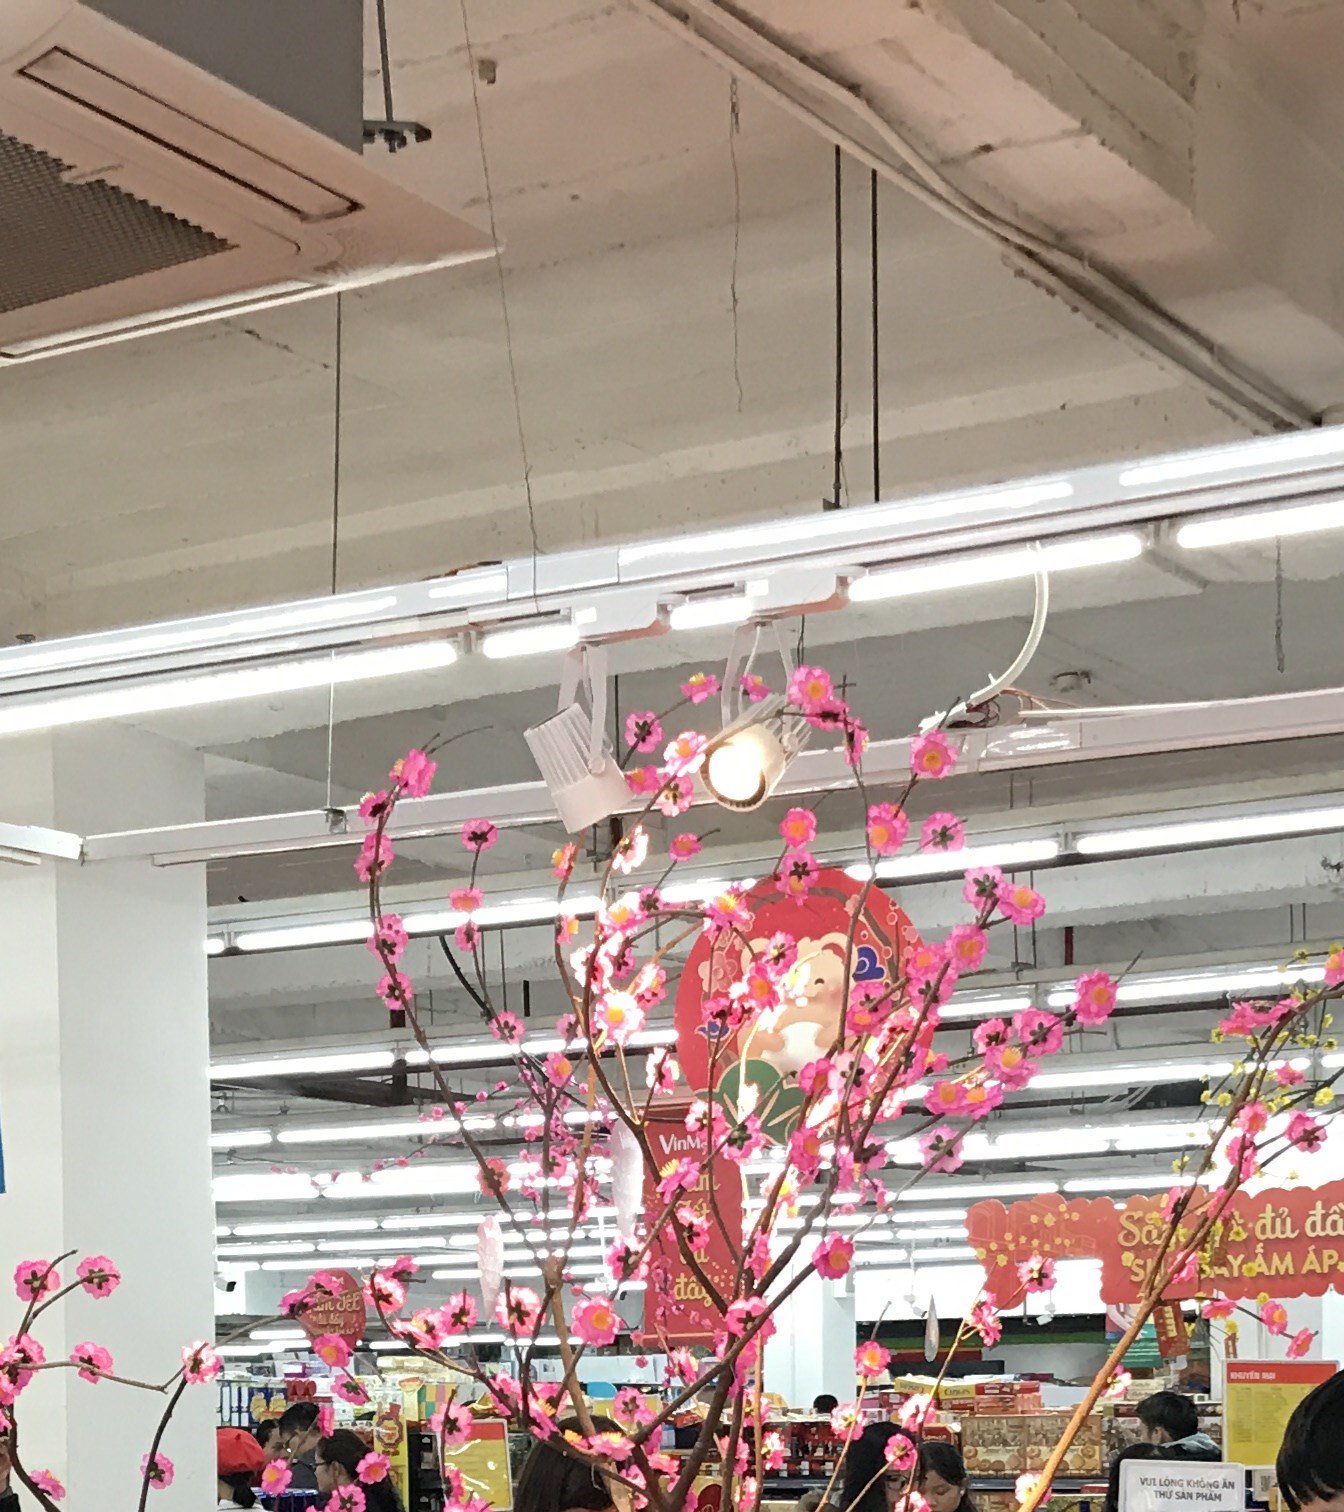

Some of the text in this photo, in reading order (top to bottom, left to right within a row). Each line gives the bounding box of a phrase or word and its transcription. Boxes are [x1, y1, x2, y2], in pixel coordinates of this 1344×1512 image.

[1256, 1203, 1299, 1240] đủ
[1301, 1244, 1339, 1274] ÁP
[1140, 1477, 1156, 1486] VUI
[1186, 1476, 1220, 1489] KHÔNG
[1222, 1478, 1235, 1490] ĂN
